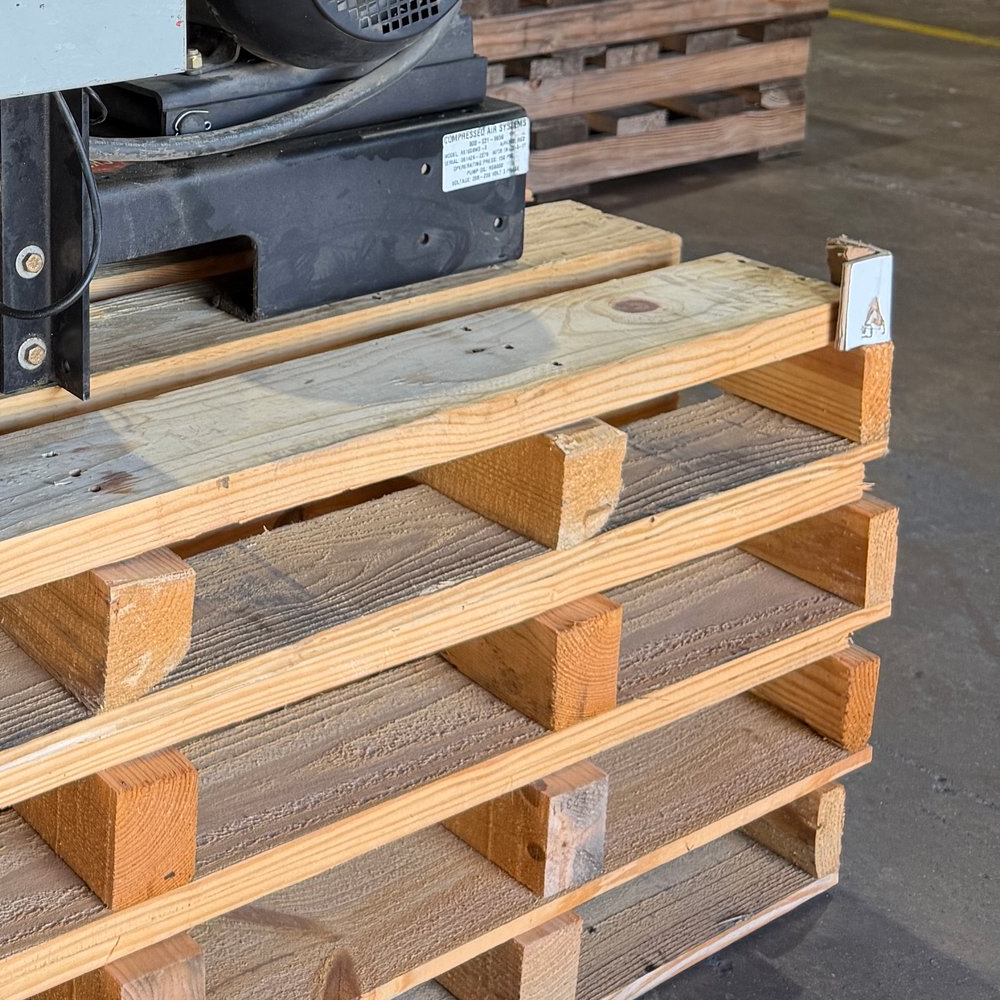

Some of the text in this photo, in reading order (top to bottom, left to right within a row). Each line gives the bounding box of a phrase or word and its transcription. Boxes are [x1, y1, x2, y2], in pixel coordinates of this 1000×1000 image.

[444, 127, 486, 144] COMPRESSED
[487, 126, 497, 134] AIR
[499, 119, 526, 132] SYSTEMS
